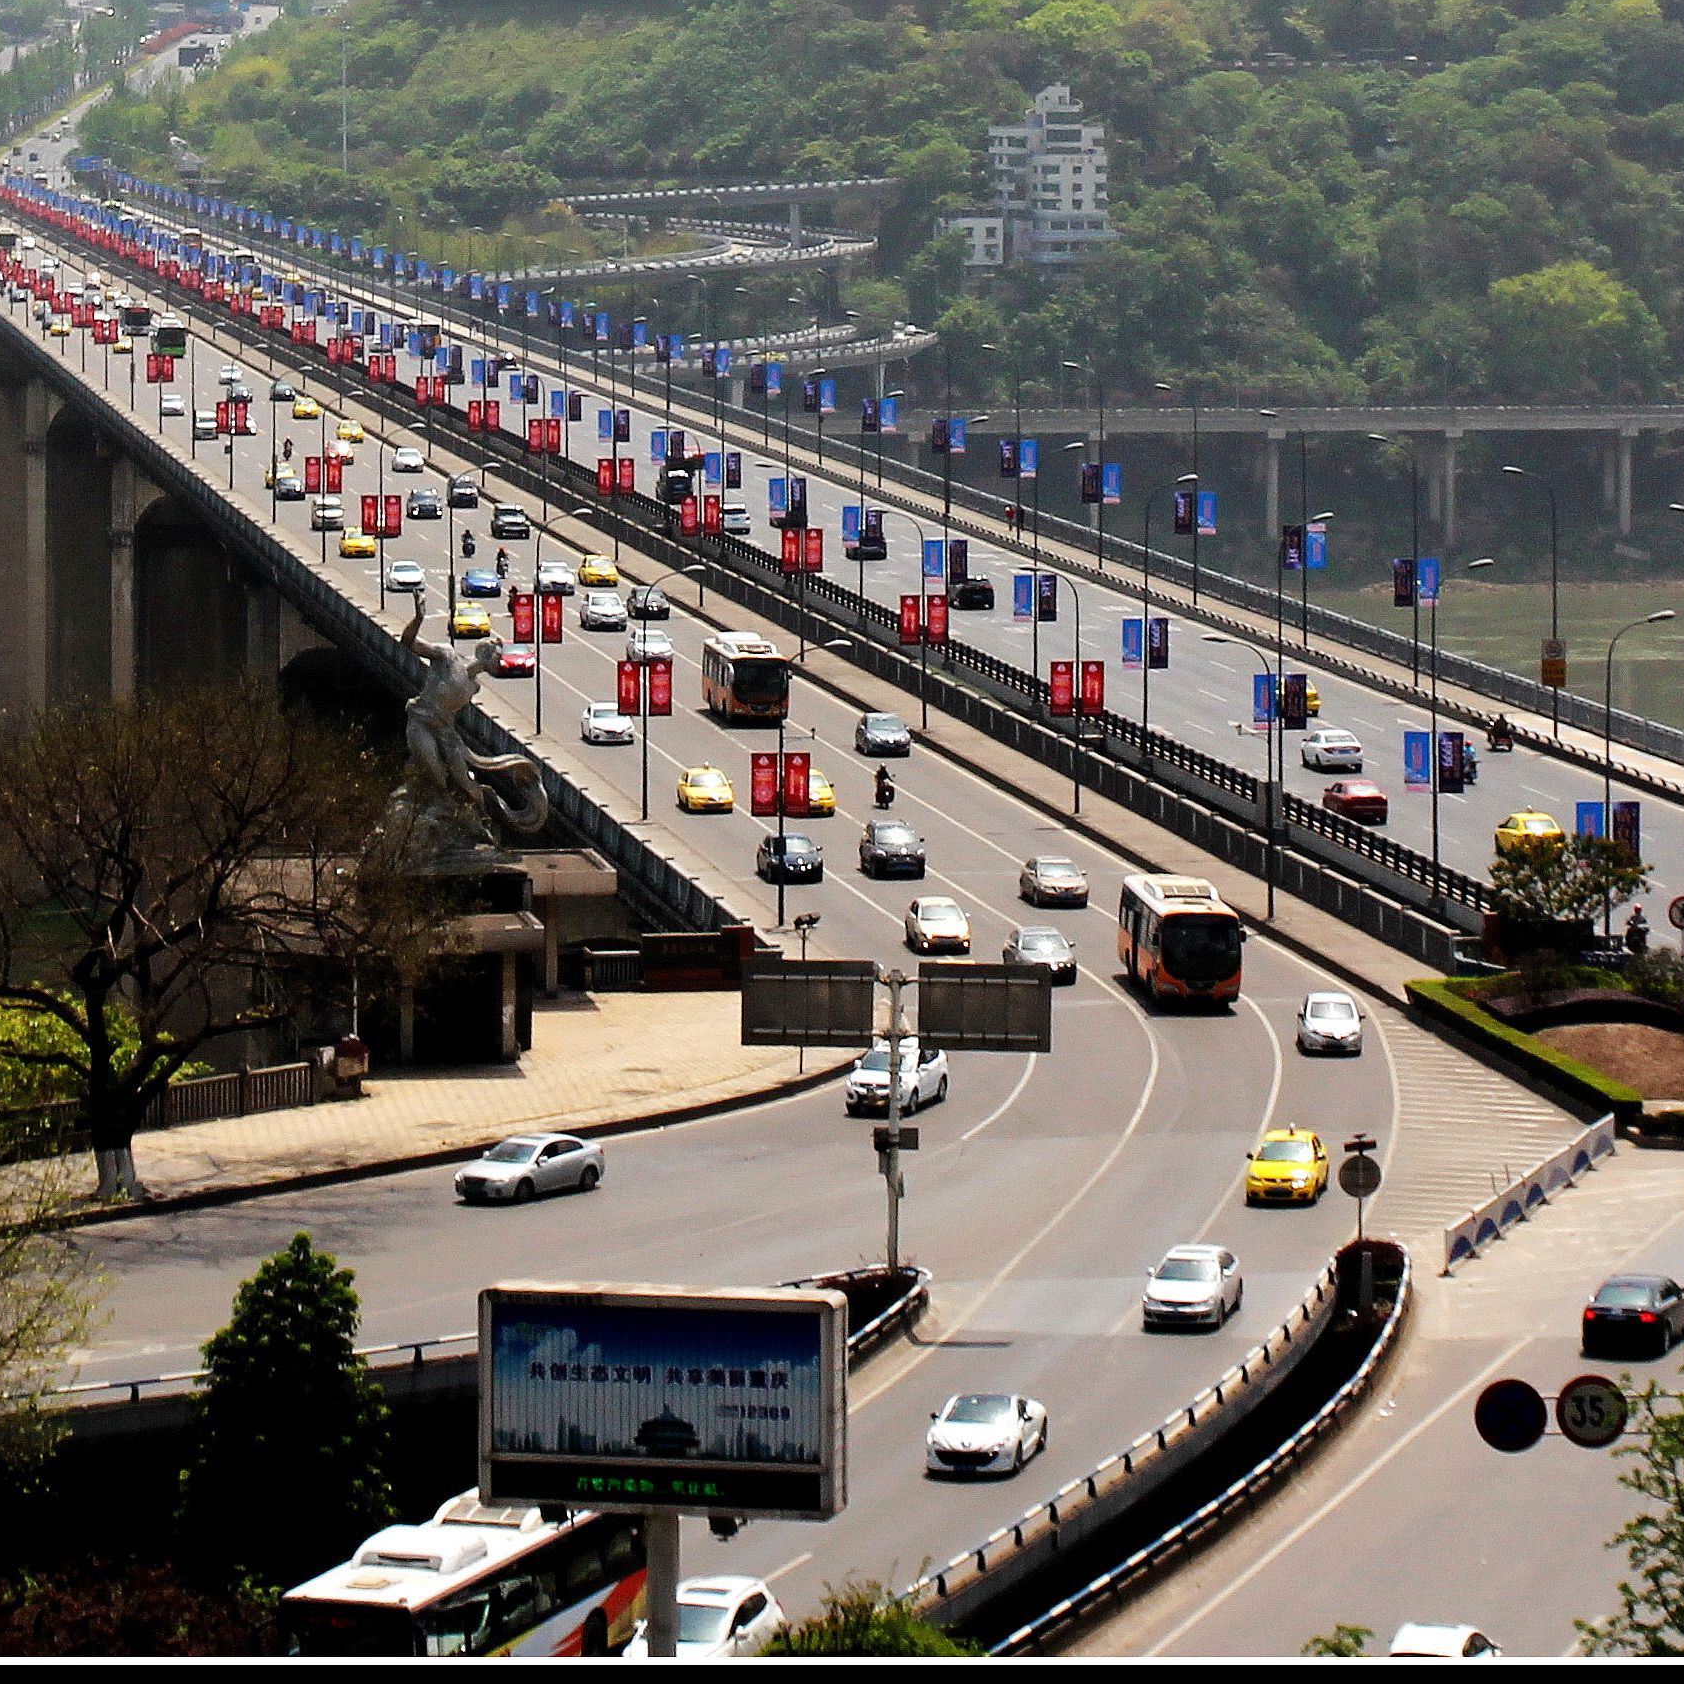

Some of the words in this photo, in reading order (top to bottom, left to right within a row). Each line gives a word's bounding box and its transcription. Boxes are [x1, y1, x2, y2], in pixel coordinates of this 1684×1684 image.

[529, 1360, 652, 1385] 共创生态文明
[1570, 1394, 1606, 1428] 35
